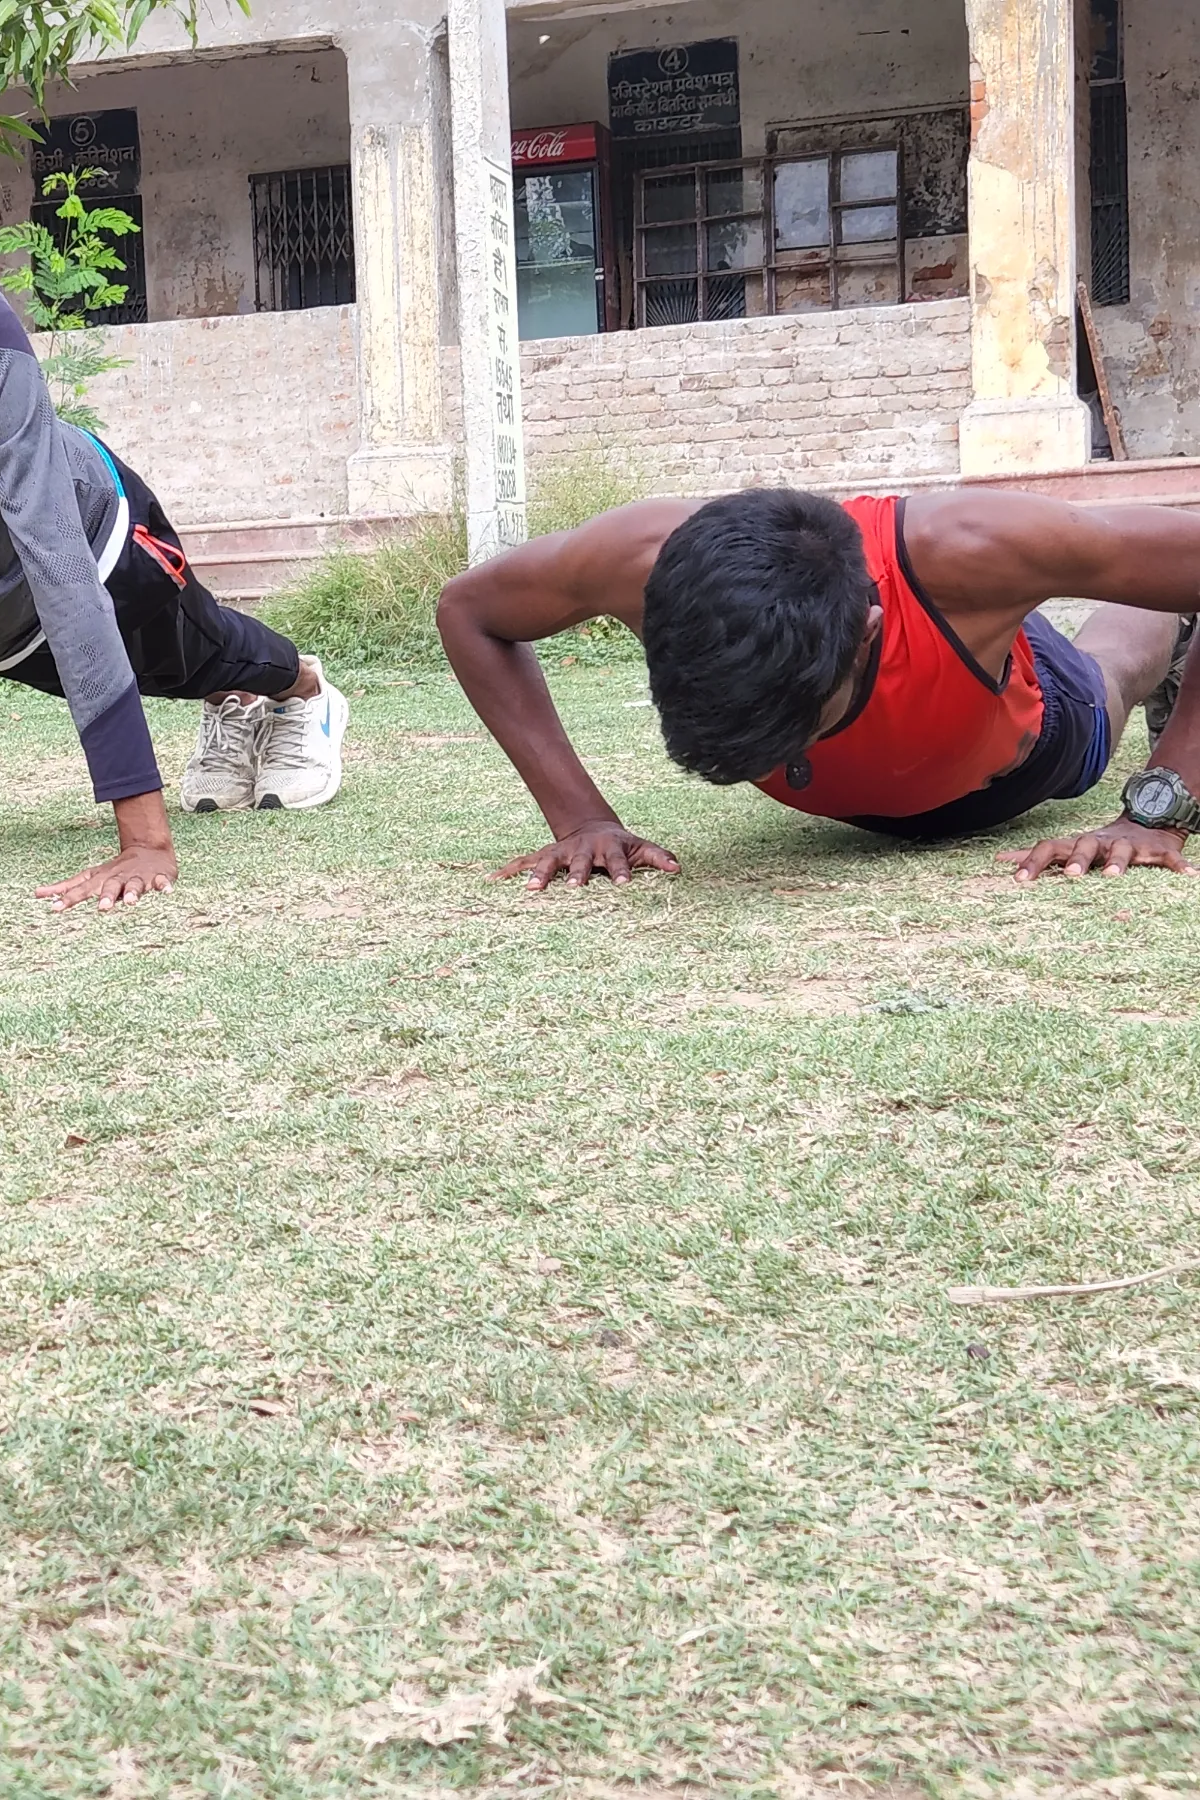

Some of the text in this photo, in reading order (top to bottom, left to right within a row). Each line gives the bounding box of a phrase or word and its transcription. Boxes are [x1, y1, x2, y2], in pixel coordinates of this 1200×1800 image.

[664, 49, 681, 70] 4
[75, 121, 90, 142] 5
[511, 131, 568, 159] ca-Cola
[496, 392, 514, 425] तथा
